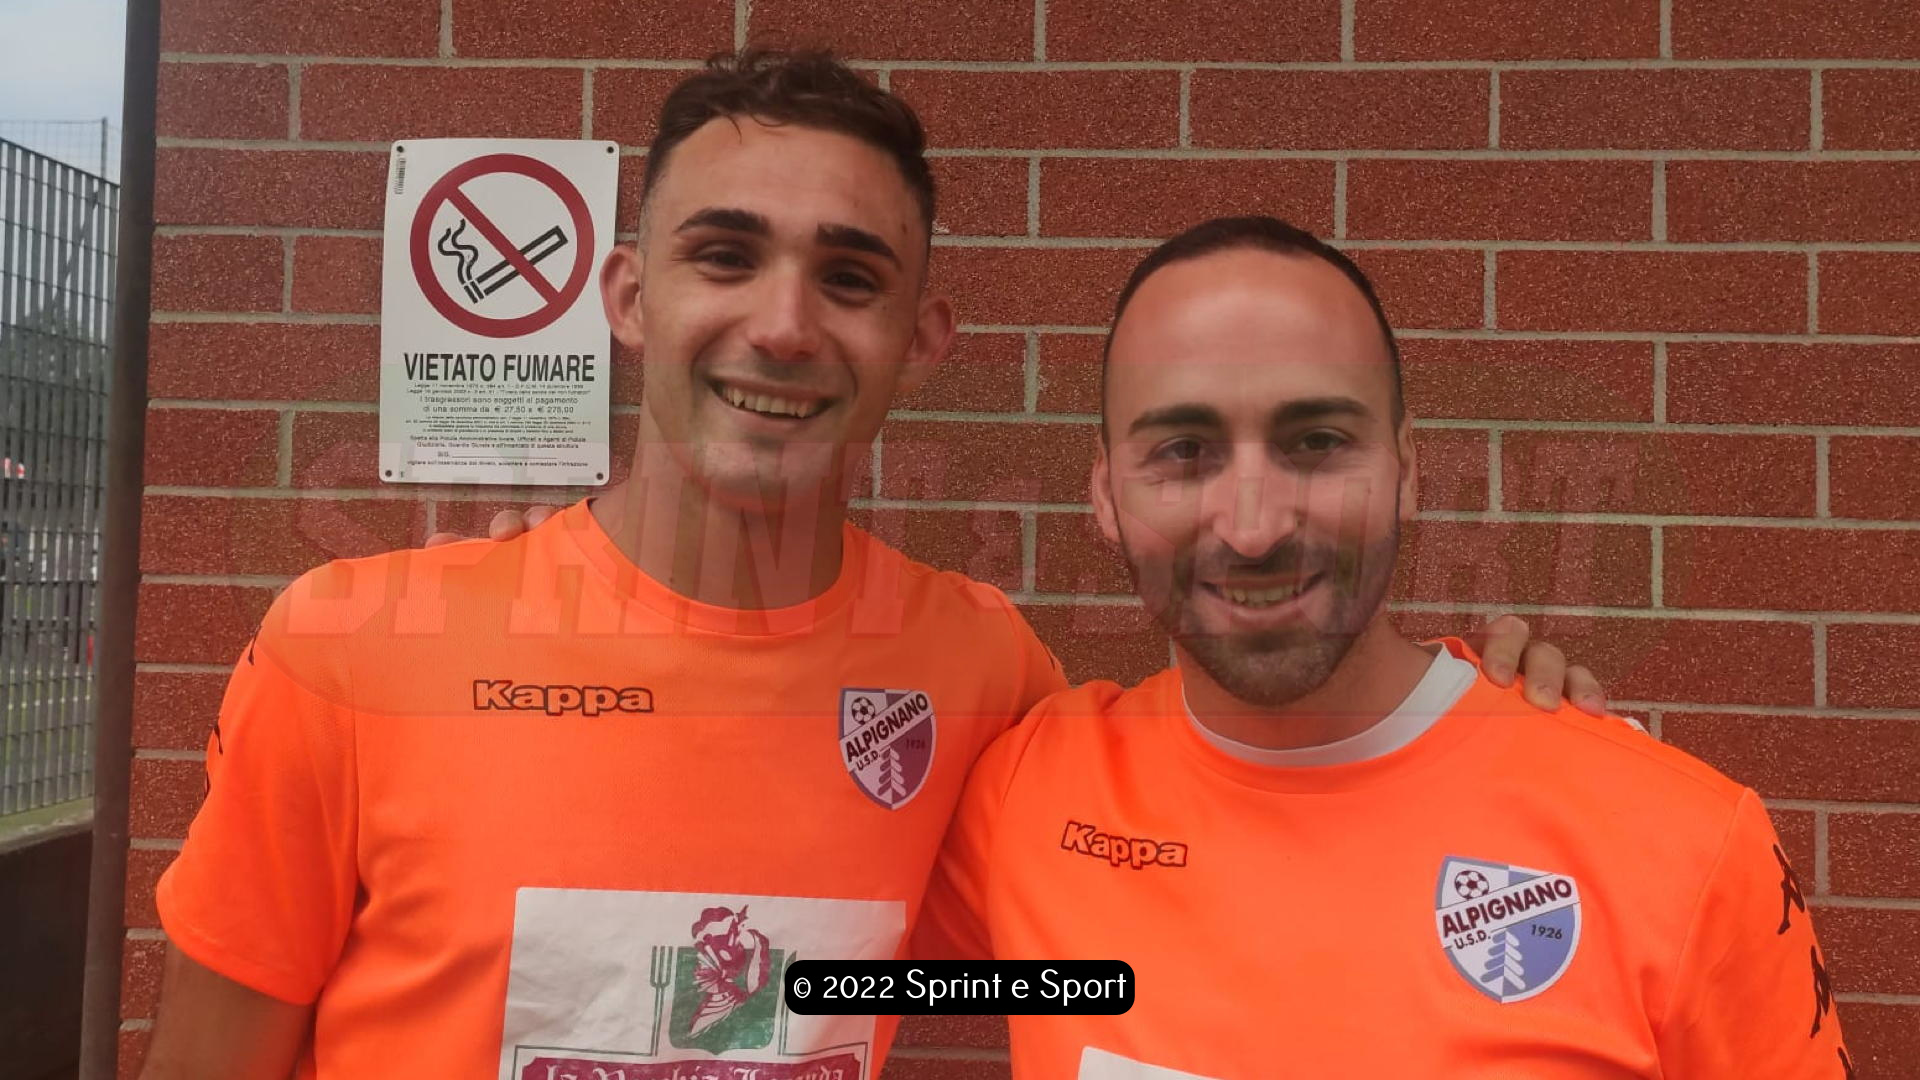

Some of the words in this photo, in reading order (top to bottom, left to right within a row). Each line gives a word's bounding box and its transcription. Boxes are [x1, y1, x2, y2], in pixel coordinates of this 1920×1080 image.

[404, 353, 495, 381] VIETATO
[503, 354, 595, 382] FUMARE
[424, 396, 471, 405] trasgressori
[493, 396, 524, 405] soggetti
[535, 397, 579, 406] pagamento
[473, 680, 655, 717] Kappa
[845, 693, 928, 763] ALPIGNANO
[1061, 820, 1188, 870] Kappa
[1442, 878, 1573, 939] ALPIGNANO
[1454, 929, 1492, 950] U.S.D.
[1530, 923, 1563, 940] 1926
